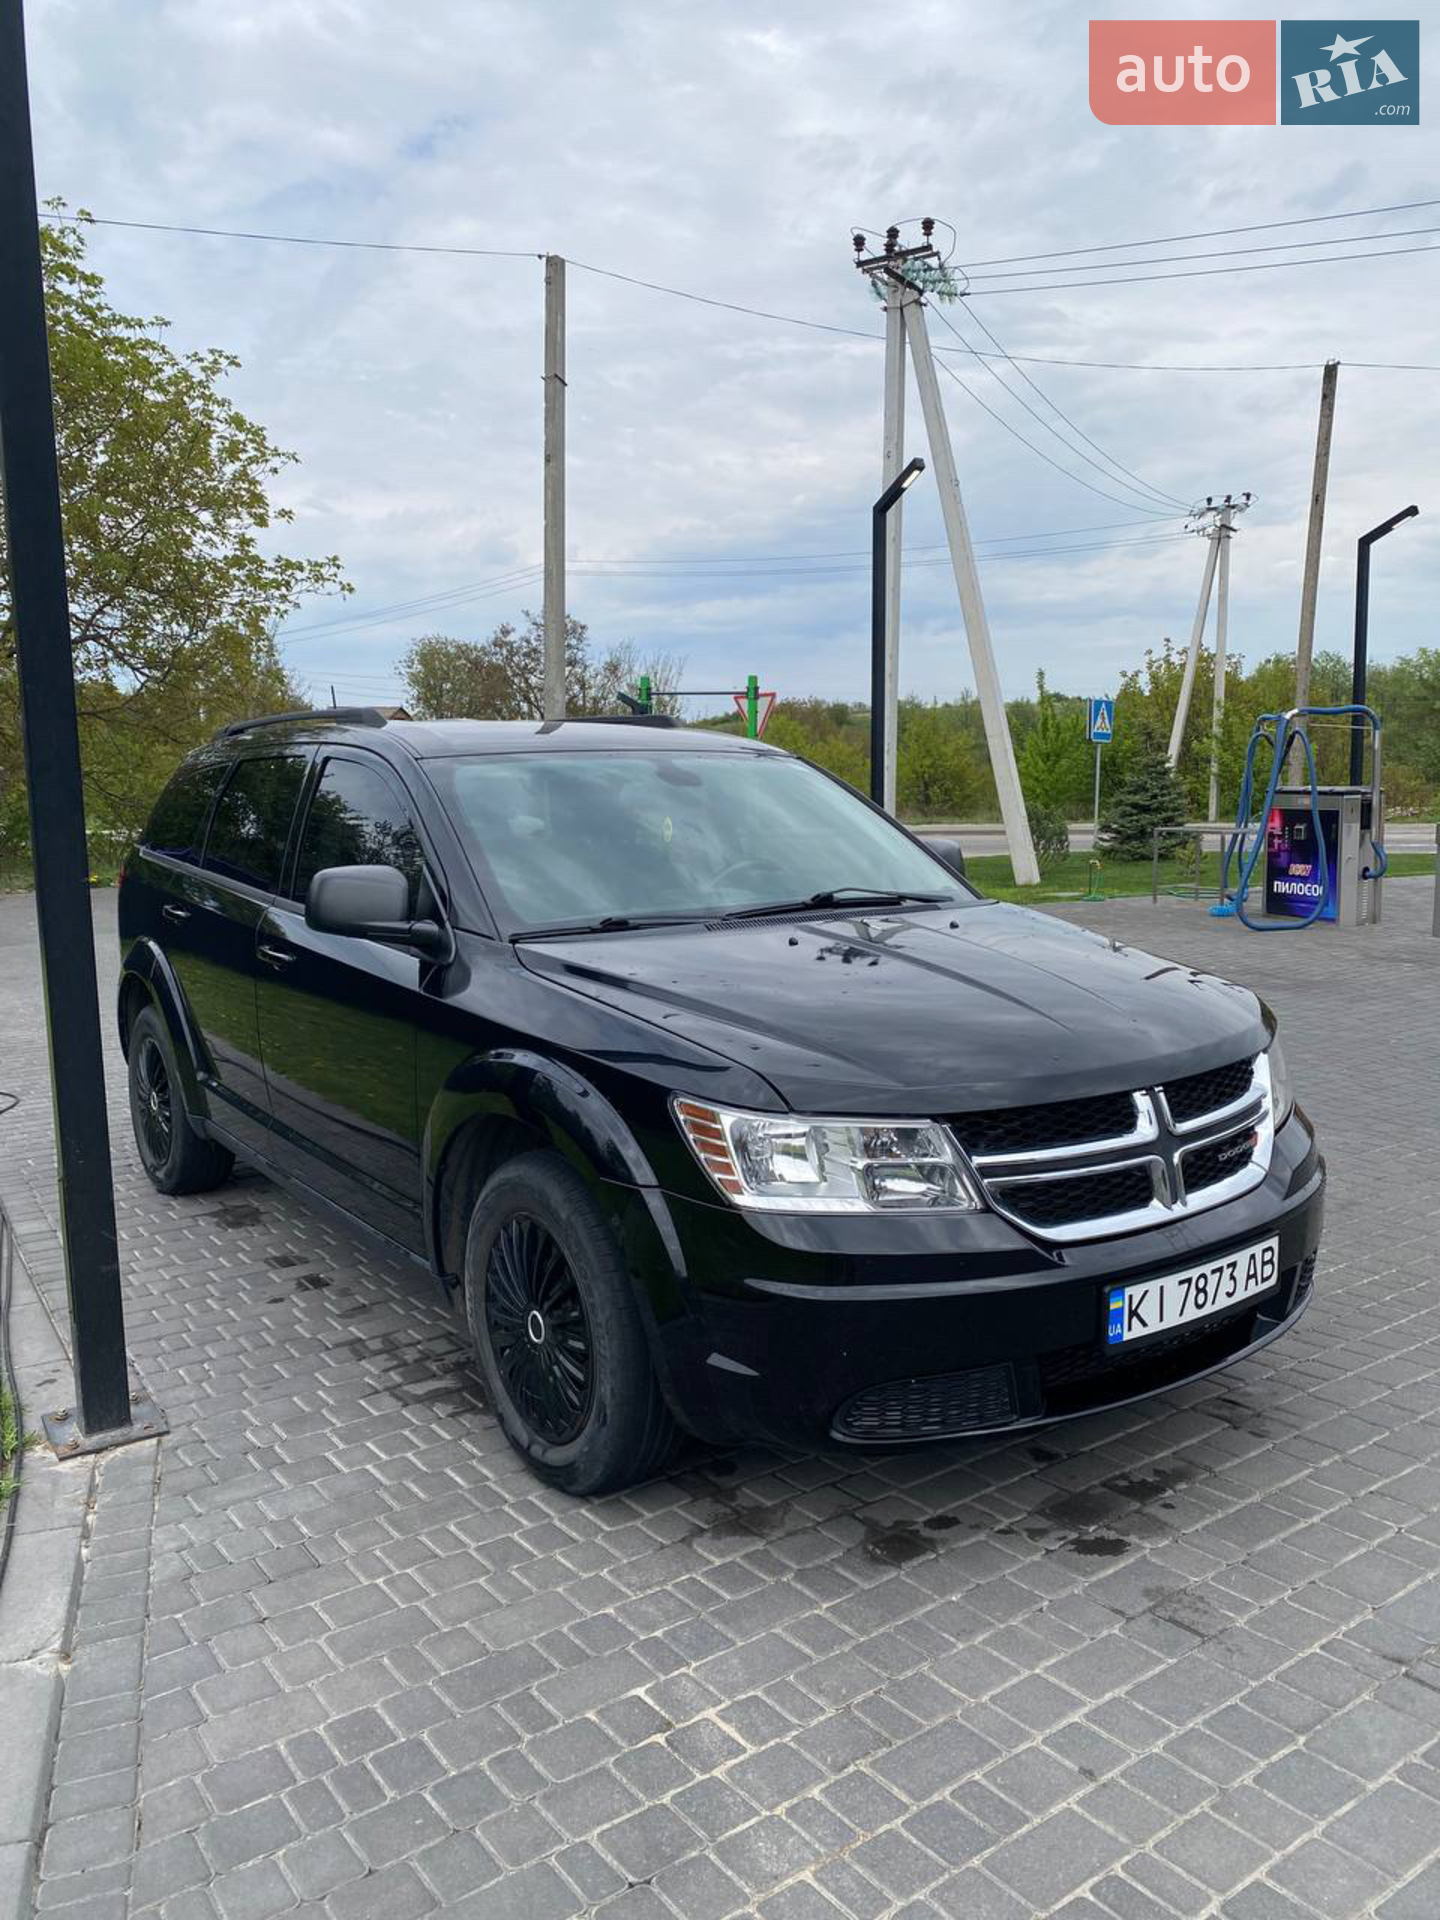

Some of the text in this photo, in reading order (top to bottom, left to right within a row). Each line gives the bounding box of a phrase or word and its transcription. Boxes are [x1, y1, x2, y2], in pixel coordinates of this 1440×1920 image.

[1127, 1246, 1276, 1332] KI 7873 AB
[1108, 1324, 1122, 1337] UA
